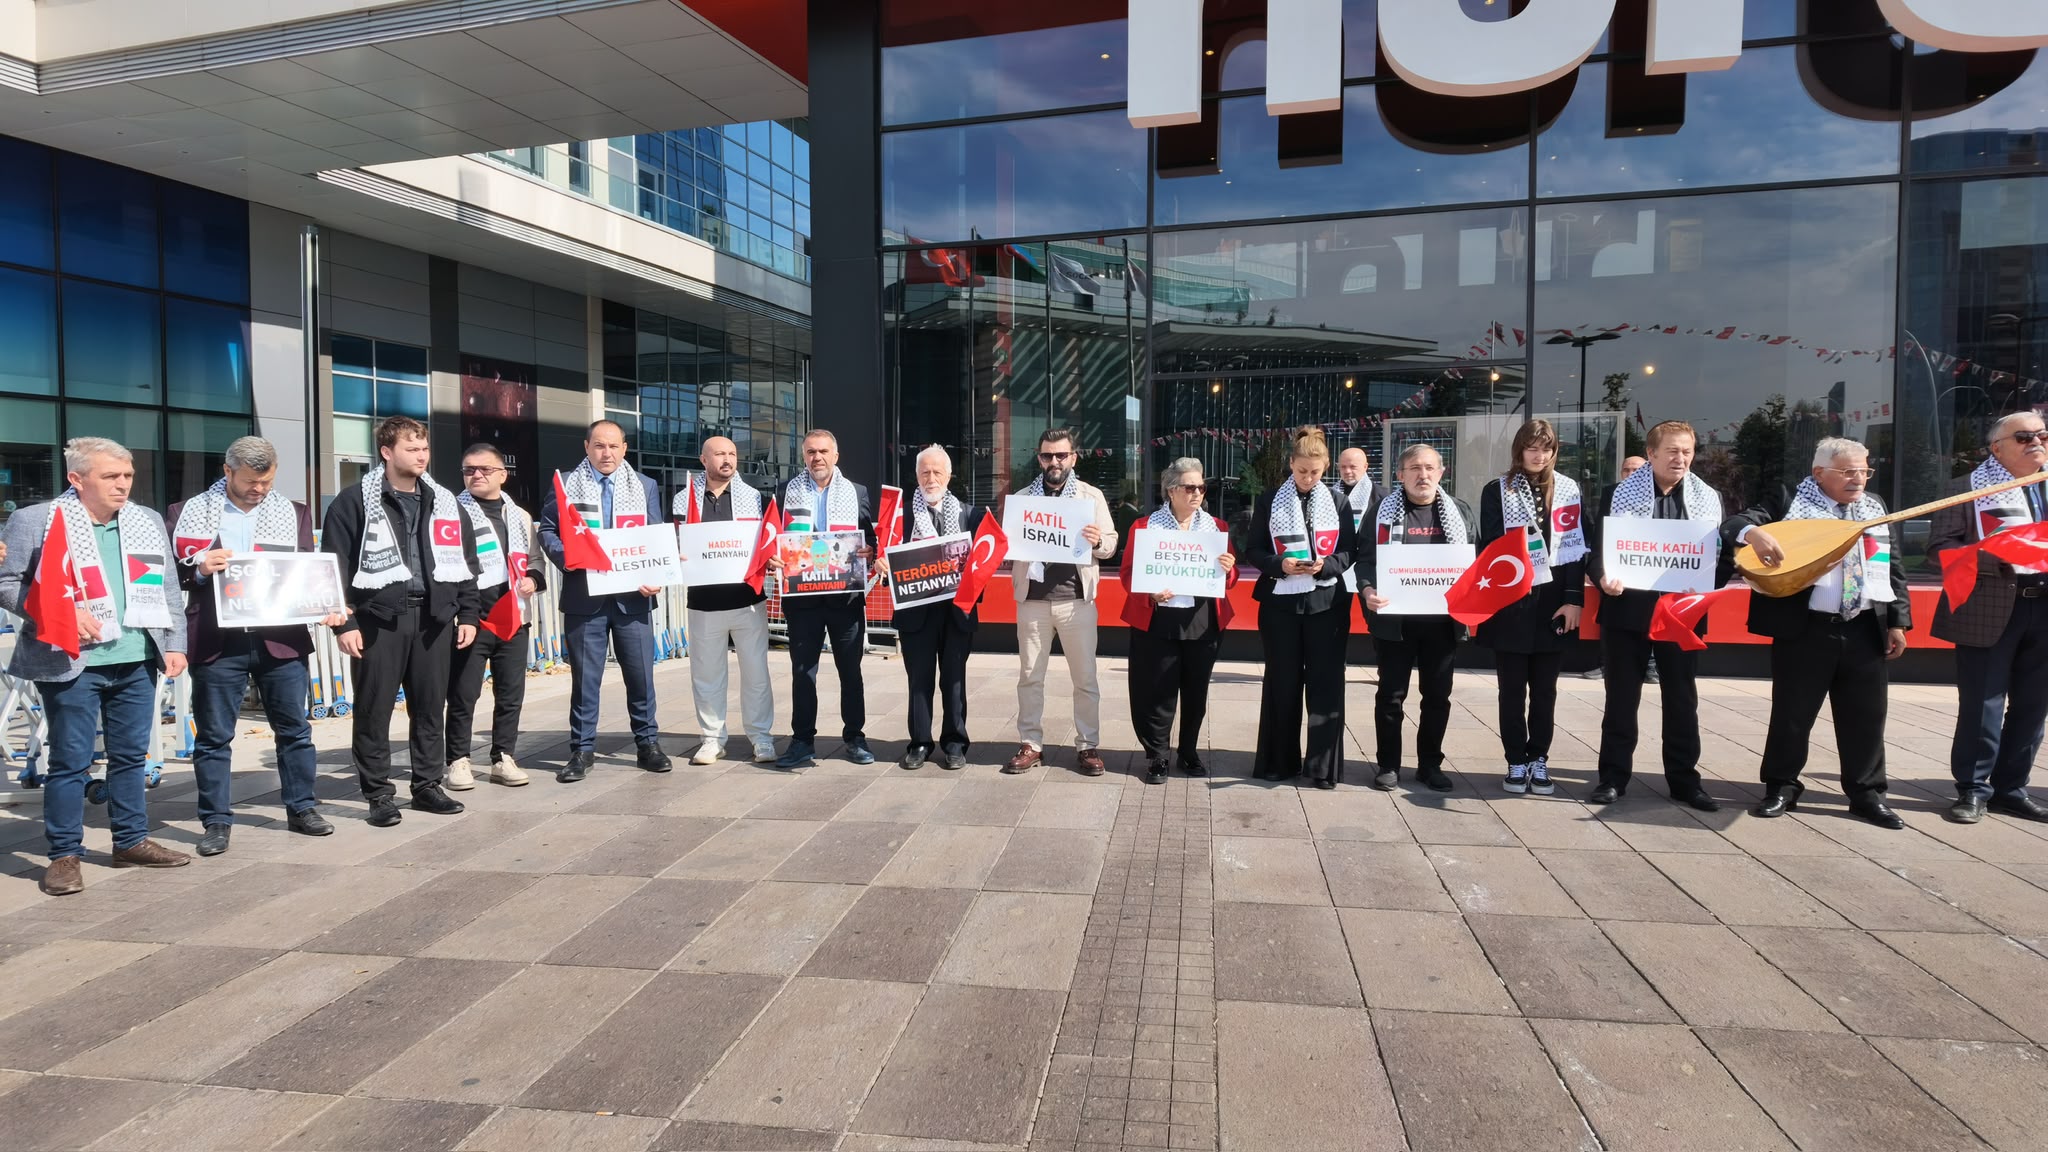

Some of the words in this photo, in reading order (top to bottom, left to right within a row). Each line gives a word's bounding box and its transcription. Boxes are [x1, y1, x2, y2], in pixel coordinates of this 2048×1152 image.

[1023, 509, 1067, 530] KATİL
[1023, 524, 1071, 548] İSRAİL
[611, 545, 647, 557] FREE
[1159, 540, 1203, 552] DÜNYA
[1616, 540, 1658, 552] BEBEK
[1662, 541, 1704, 555] KATİLİ
[702, 550, 749, 559] NETANYAHU
[1155, 551, 1208, 563] BEŞTEN
[1619, 553, 1701, 570] NETANYAHU
[606, 556, 671, 573] LESTINE
[1145, 562, 1216, 579] BÜYÜKTÜR
[797, 580, 846, 592] NETANYAHU
[898, 573, 962, 596] NETANYAH
[1400, 577, 1456, 586] YANINDAYIZ
